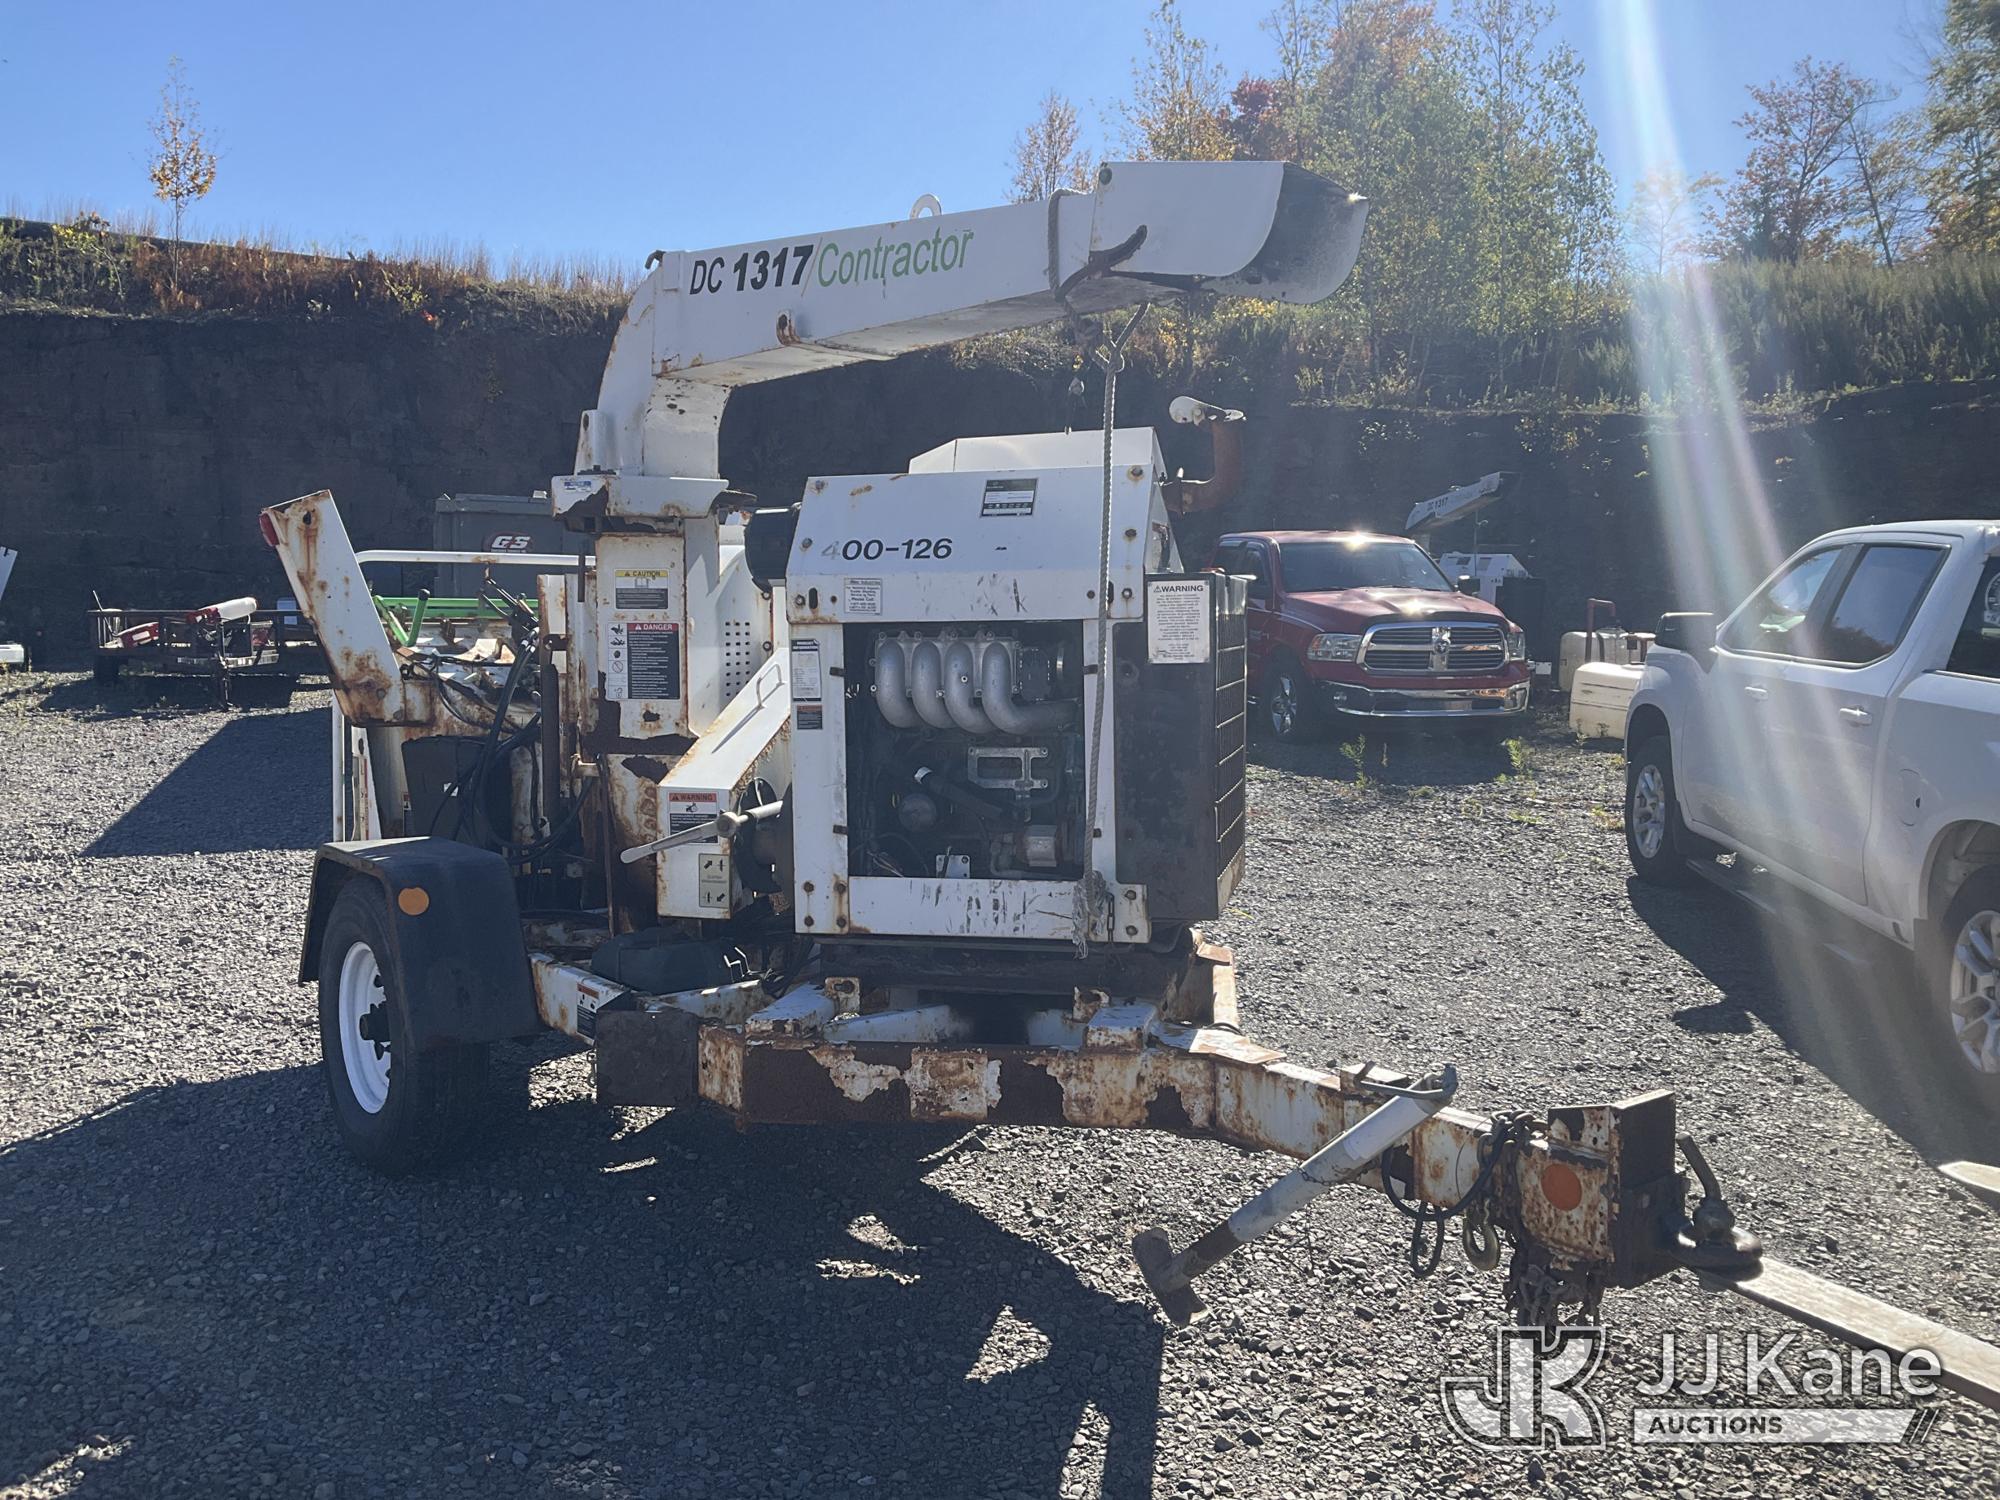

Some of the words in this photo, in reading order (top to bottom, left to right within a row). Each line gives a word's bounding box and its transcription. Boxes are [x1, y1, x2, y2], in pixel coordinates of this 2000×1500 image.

[689, 256, 726, 295] DC
[733, 244, 814, 292] 1317
[817, 227, 975, 288] Contractor
[491, 535, 531, 549] GS
[821, 538, 953, 560] 400-126
[643, 623, 673, 631] DANGER
[680, 793, 713, 801] WARNING
